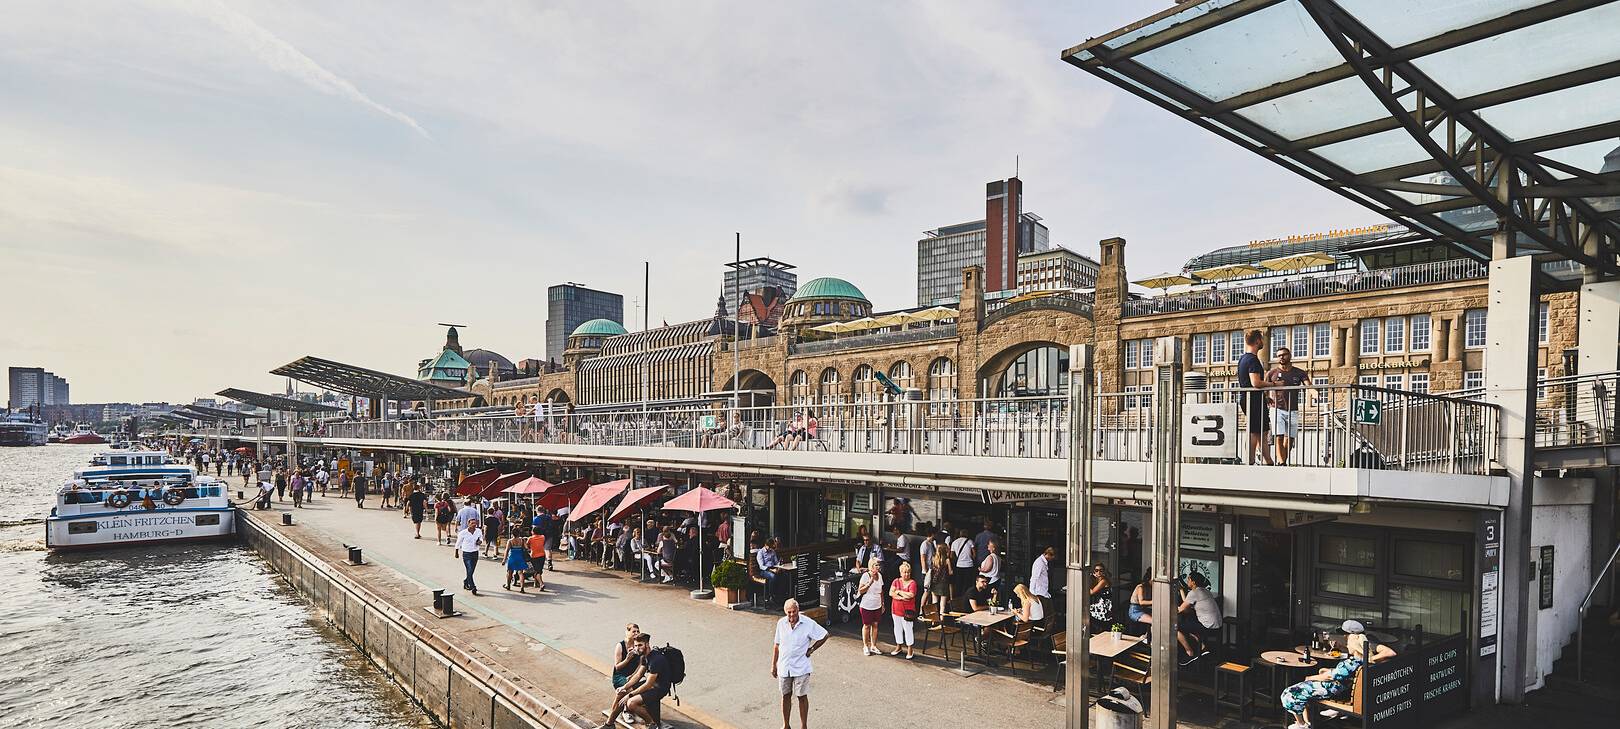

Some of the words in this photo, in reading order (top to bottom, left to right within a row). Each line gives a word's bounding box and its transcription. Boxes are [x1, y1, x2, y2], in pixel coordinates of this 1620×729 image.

[1248, 238, 1281, 248] HOTEL
[1287, 232, 1323, 244] HAFEN
[1329, 224, 1389, 239] HAMBURG
[1191, 415, 1225, 446] 3
[97, 519, 132, 530] KLEIN
[135, 516, 195, 527] FRITZCHEN
[1487, 525, 1495, 540] 3
[113, 528, 183, 540] HAMBURG-D
[1428, 656, 1439, 666] FISH
[1443, 648, 1457, 661] CHIPS
[1430, 665, 1456, 682] BRATWURST
[1375, 683, 1410, 704] CURRYWURST
[1423, 685, 1442, 701] FRISCHE
[1442, 678, 1461, 694] KRABBEN
[1373, 705, 1396, 723] POMMES
[1396, 699, 1412, 714] FRITES
